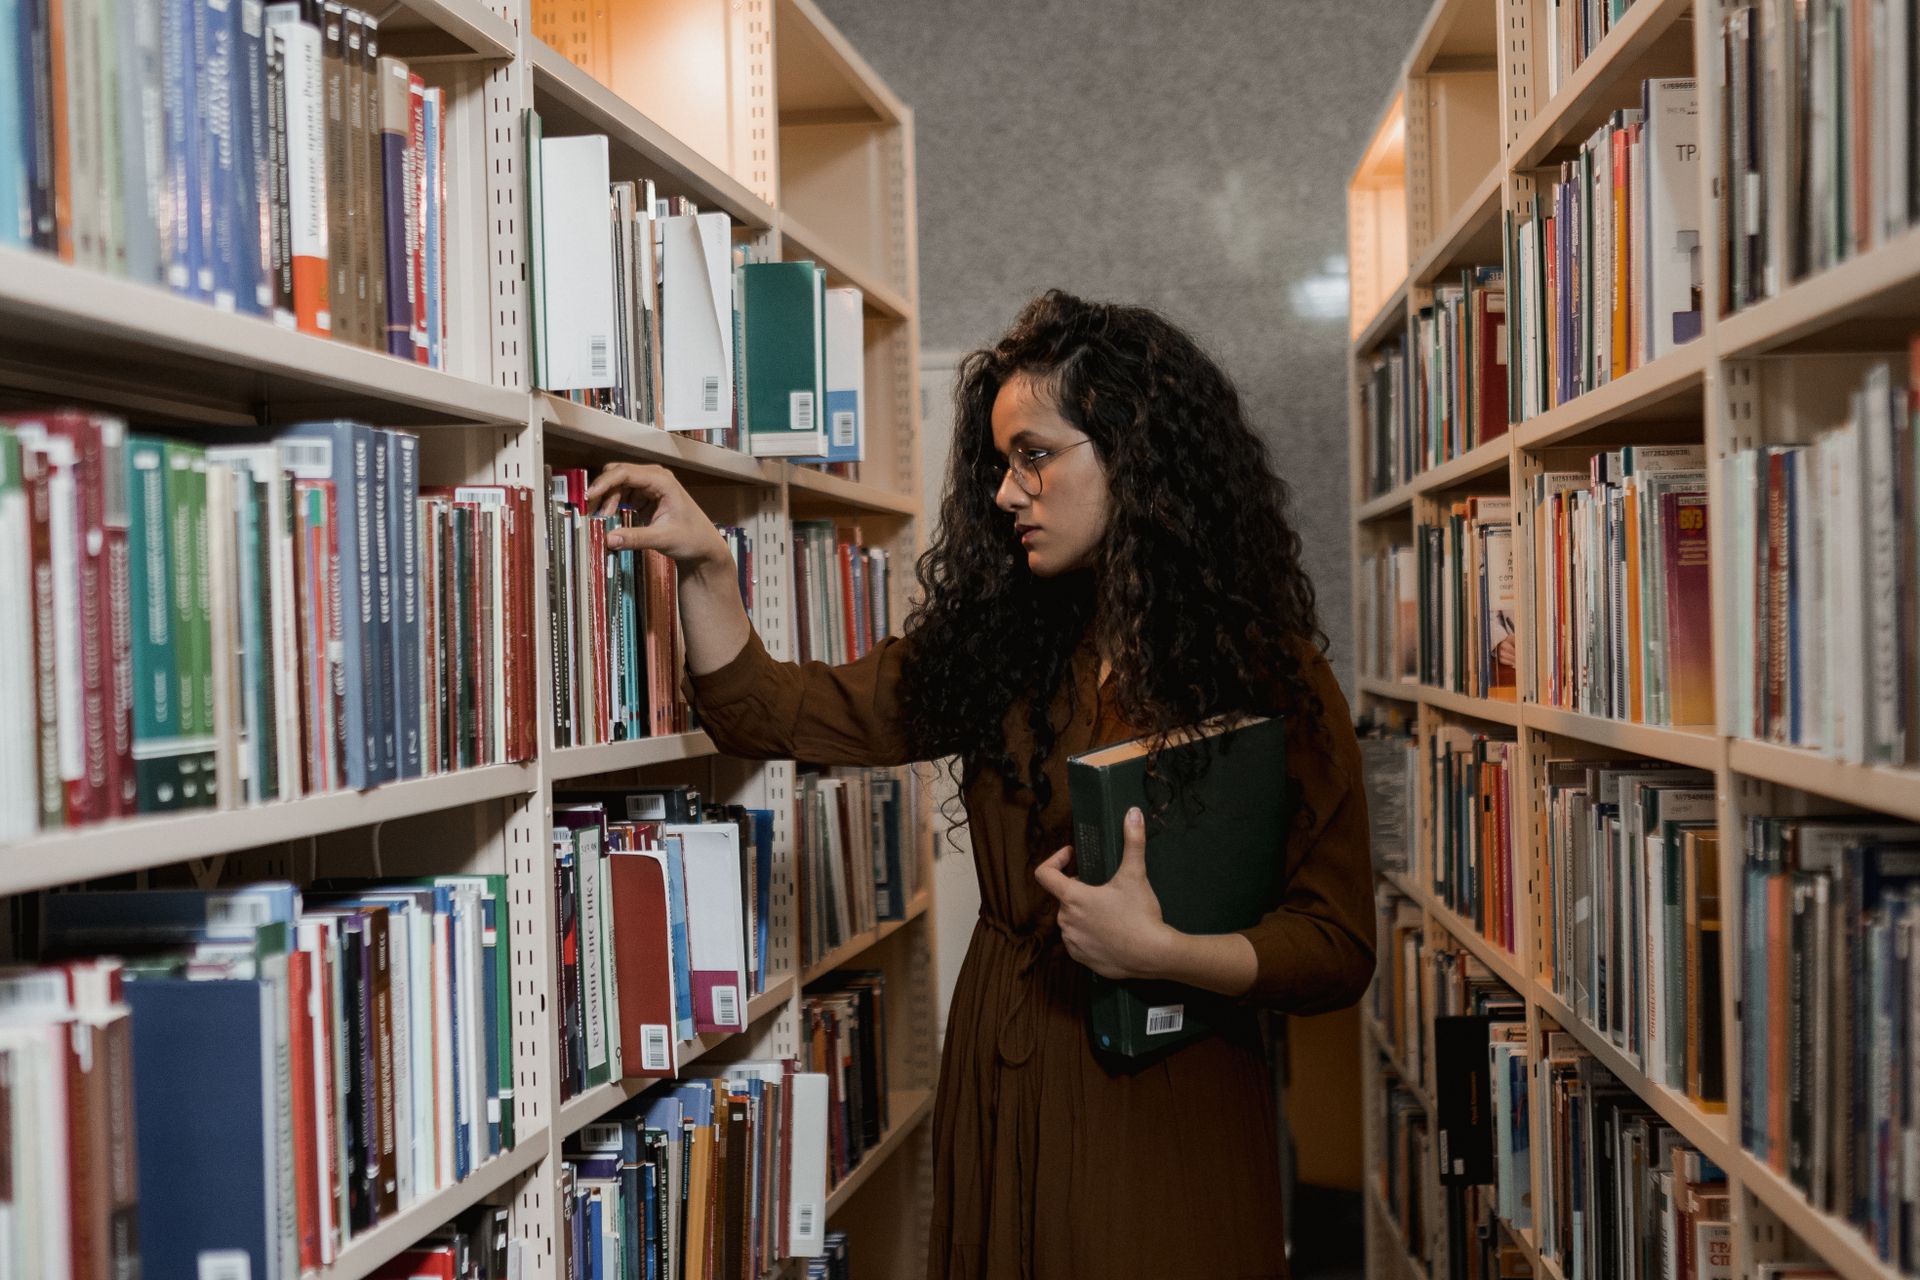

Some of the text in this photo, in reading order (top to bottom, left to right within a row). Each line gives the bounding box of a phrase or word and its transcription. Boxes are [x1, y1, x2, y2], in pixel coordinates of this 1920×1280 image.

[1675, 144, 1700, 161] ТР
[552, 611, 563, 728] КРИМИНОЛОГИЯ
[585, 874, 599, 1049] КРИМИНАЛИСТИКА
